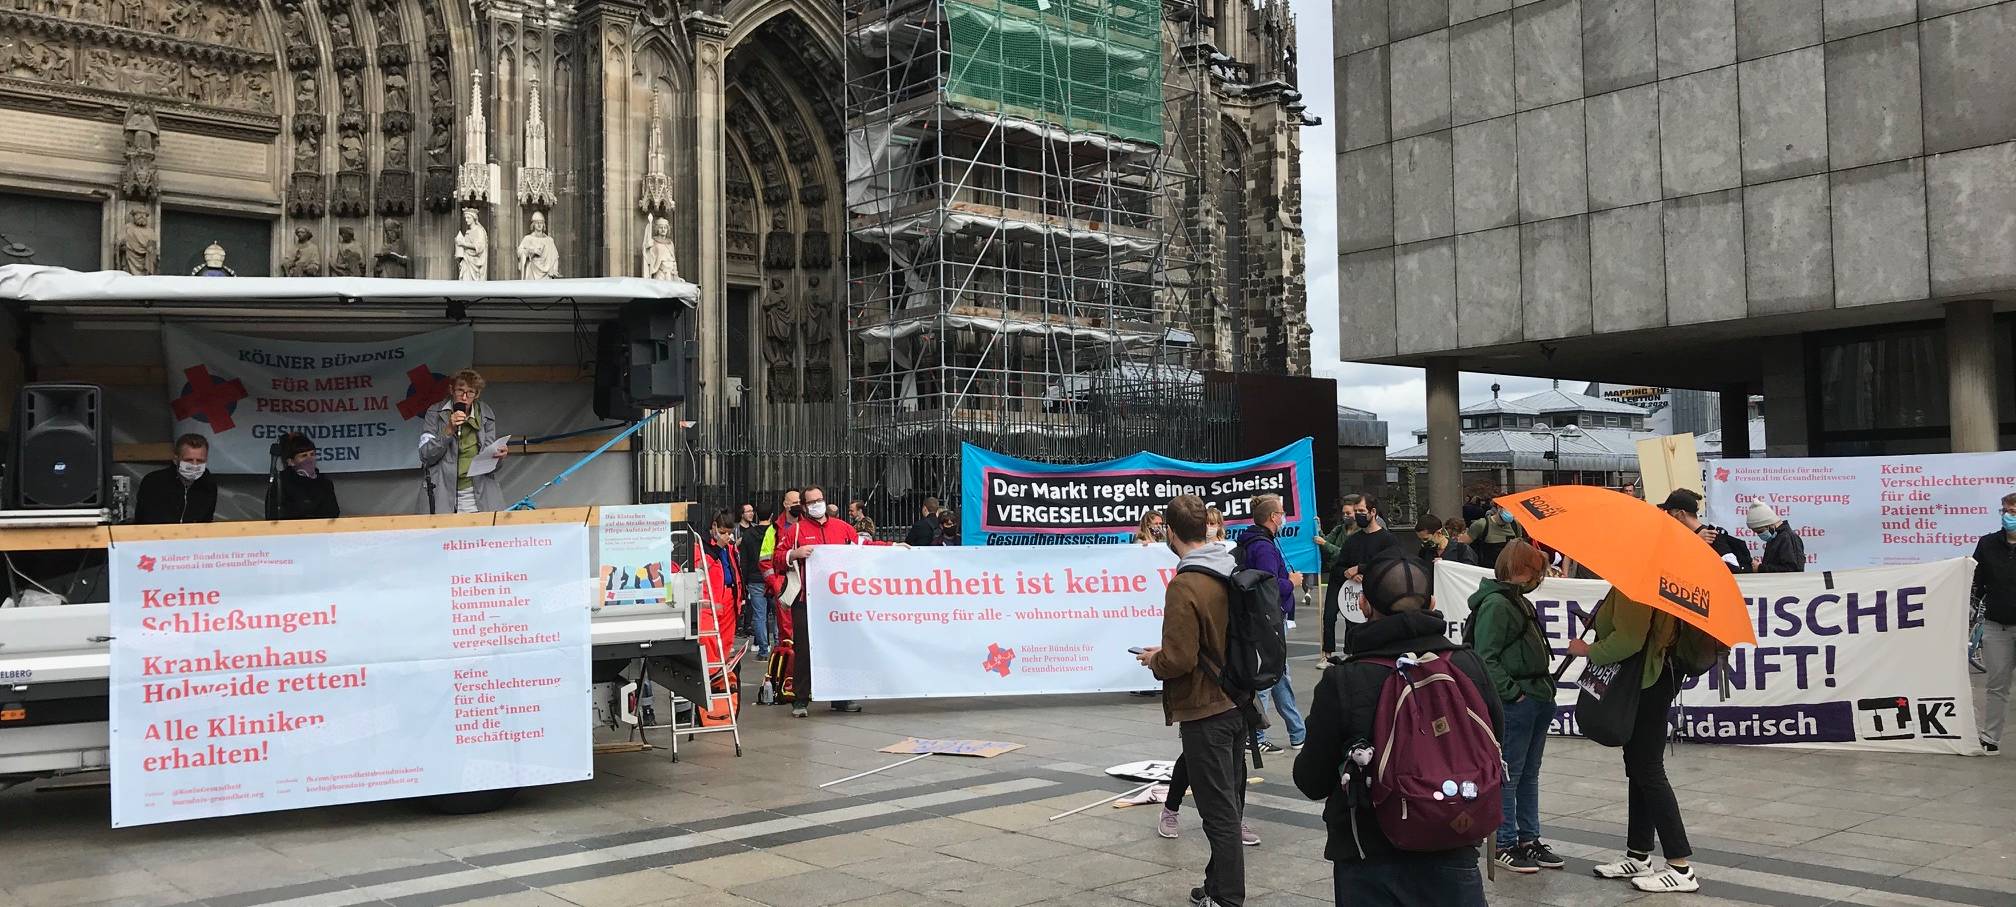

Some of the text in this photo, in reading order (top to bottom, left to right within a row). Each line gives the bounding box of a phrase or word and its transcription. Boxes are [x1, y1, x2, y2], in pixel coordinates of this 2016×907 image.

[239, 347, 405, 369] KÖLNER BÜNDNIS
[271, 375, 373, 392] FÜR MEHR
[1604, 388, 1647, 397] MAPPING
[256, 395, 389, 413] PERSONAL IM
[252, 422, 396, 439] GESUNDHEITS-
[315, 446, 360, 461] ESEN
[1735, 466, 1760, 474] Kölner
[1797, 466, 1809, 474] für
[1812, 466, 1833, 474] mehr
[1881, 464, 1923, 475] Keine
[1735, 474, 1768, 482] Personal
[1881, 475, 2015, 488] Verschlechterung
[993, 473, 1284, 501] Der Markt regelt einen Scheiss!
[1735, 492, 1850, 506] Gute Versorgung
[1881, 490, 1931, 502] für die
[1882, 518, 1938, 530] und die
[442, 536, 552, 551] #klinikenerhalten
[161, 550, 270, 562] Kölner Bündnis für mehr
[161, 561, 199, 571] Personal
[202, 561, 213, 569] im
[451, 571, 528, 585] Die Kliniken
[828, 568, 1004, 596] Gesundheit
[1016, 570, 1055, 595] ist
[1064, 567, 1147, 594] keine
[142, 587, 221, 609] Keine
[451, 585, 511, 598] bleiben in
[1659, 576, 1710, 609] BODEN
[1694, 586, 1710, 598] AM
[452, 596, 531, 610] kommunaler
[142, 604, 337, 635] Schließungen!
[452, 611, 485, 623] Hand
[828, 610, 863, 622] Gute
[865, 609, 950, 625] Versorgung
[952, 607, 975, 621] für
[978, 607, 1003, 621] alle
[1014, 606, 1098, 621] wohnortnah
[1102, 605, 1128, 618] und
[1131, 604, 1165, 618] beda
[452, 622, 529, 637] und gehören
[453, 632, 560, 650] vergesellschaftet!
[1021, 643, 1094, 653] Kölner Bündnis für
[142, 646, 327, 676] Krankenhaus
[1021, 654, 1089, 663] mehr Personal im
[0, 669, 33, 679] ELBERG
[454, 668, 488, 680] Keine
[1021, 664, 1094, 673] Gesundheitswesen
[142, 666, 367, 703] Holweide retten!
[454, 677, 561, 692] Verschlechterung
[454, 693, 496, 706] für die
[144, 710, 325, 742] Alle Kliniken
[455, 718, 501, 732] und die
[1667, 711, 1818, 739] lidarisch
[455, 727, 545, 745] Beschäftigten!
[143, 740, 268, 772] erhalten!
